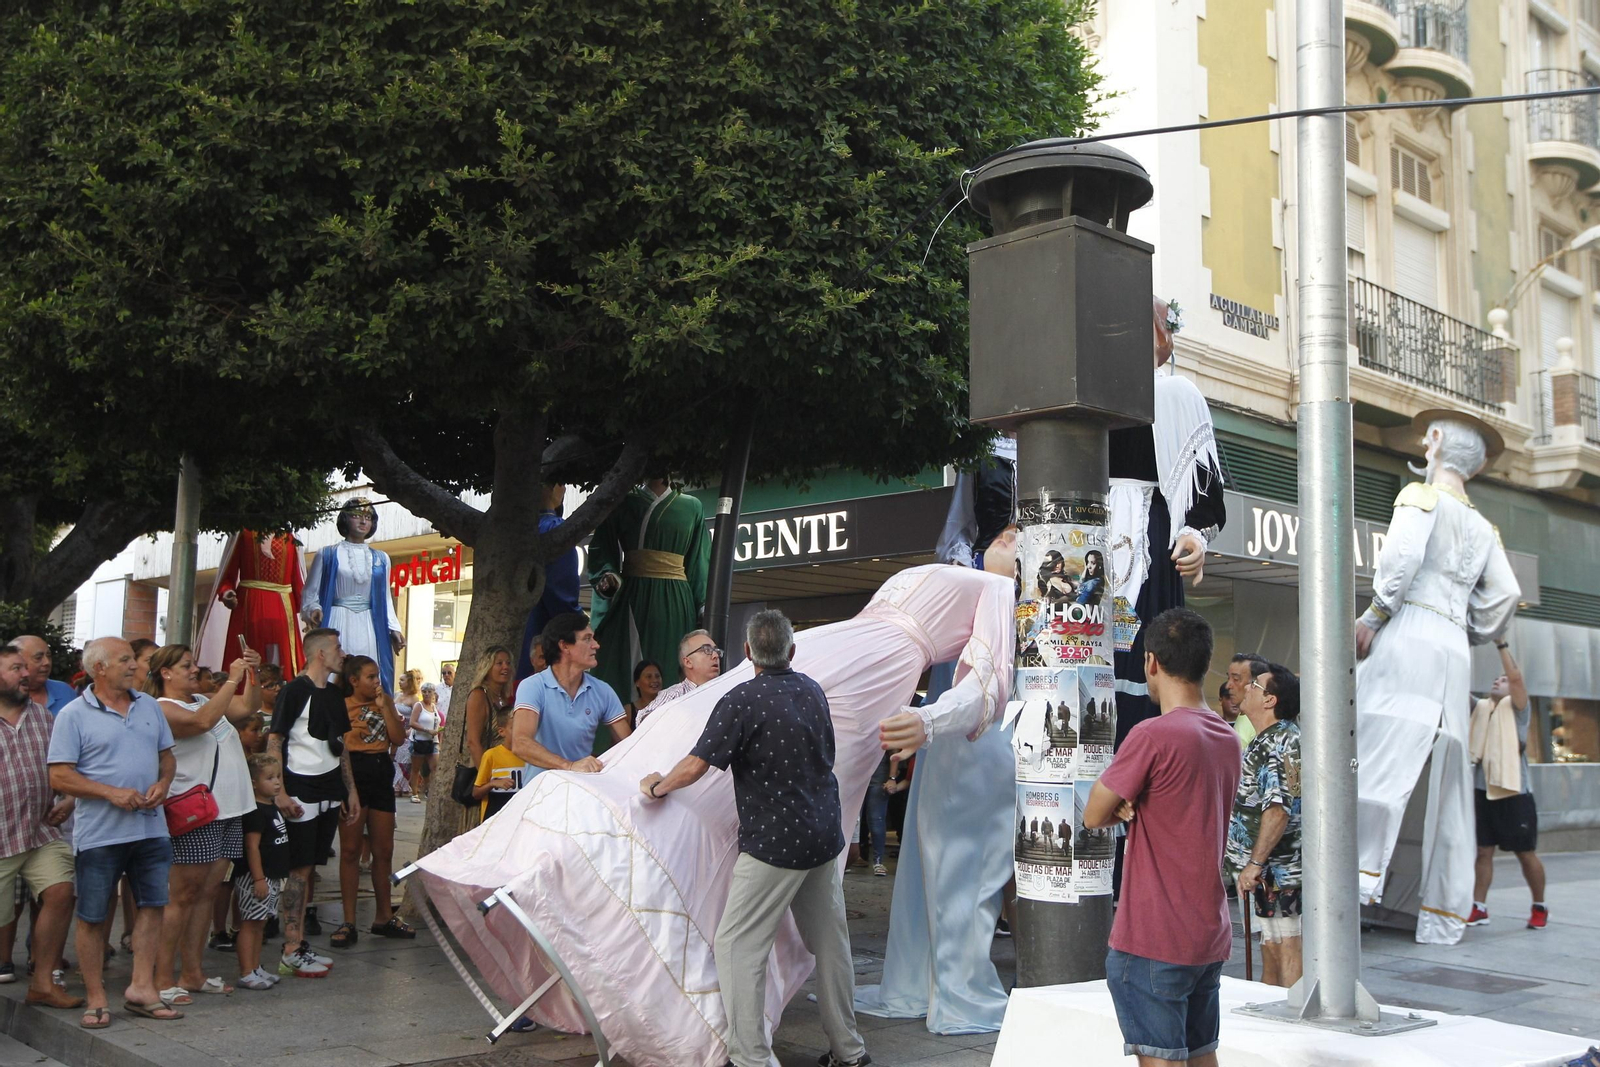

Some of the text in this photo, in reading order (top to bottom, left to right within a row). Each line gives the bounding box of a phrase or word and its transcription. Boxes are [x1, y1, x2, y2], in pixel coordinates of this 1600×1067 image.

[1211, 295, 1265, 325] AGUILAR
[709, 510, 848, 562] GENTE
[1048, 603, 1104, 625] HOW
[1055, 647, 1090, 658] 8-9-10
[1053, 676, 1058, 684] G
[1055, 748, 1073, 757] MAR
[1025, 791, 1059, 801] HOMBRES G
[1044, 864, 1054, 876] DE
[1055, 866, 1072, 877] MAR
